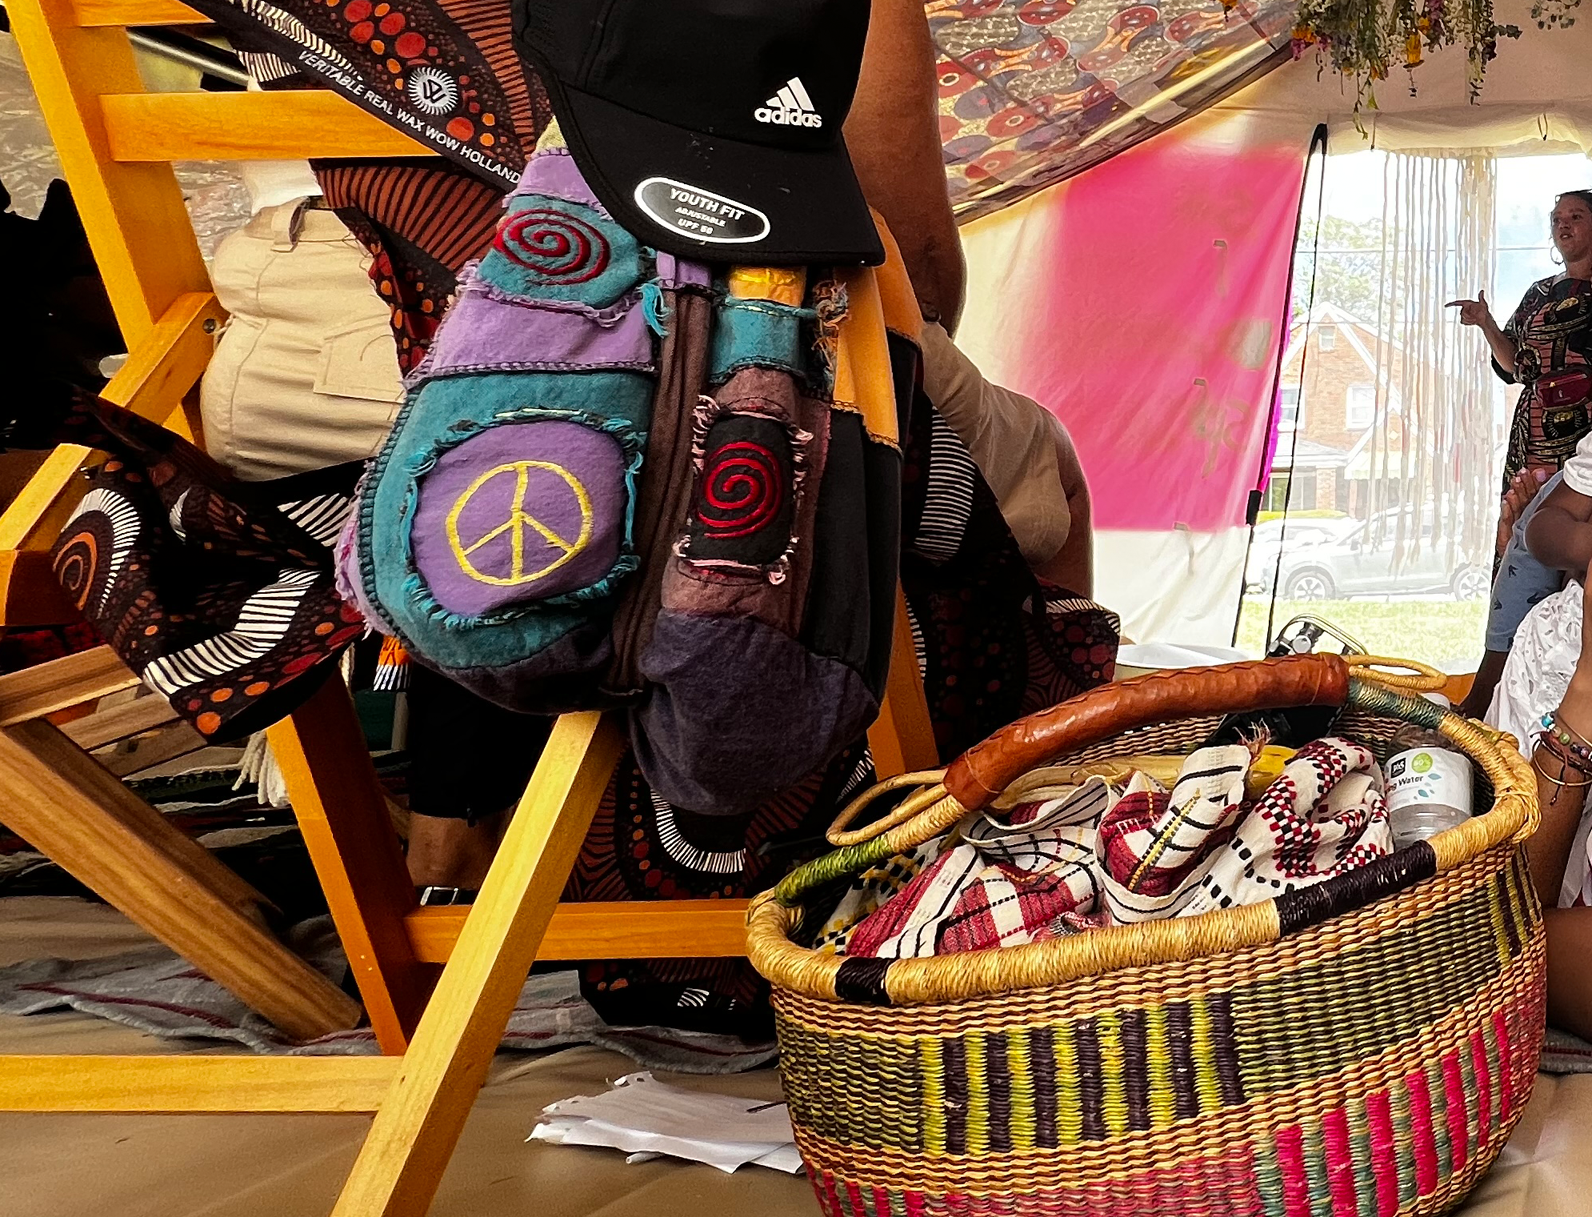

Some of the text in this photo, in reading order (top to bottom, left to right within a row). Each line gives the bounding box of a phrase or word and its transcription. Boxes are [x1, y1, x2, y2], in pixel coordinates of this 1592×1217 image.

[298, 50, 521, 184] VERITABLE REAL WAX WOW HOLLAND
[754, 106, 822, 128] adidas
[670, 188, 745, 220] YOUTH FIT
[675, 207, 726, 227] ADJUSTABLE
[678, 218, 700, 230] UPF
[1398, 776, 1424, 786] Water
